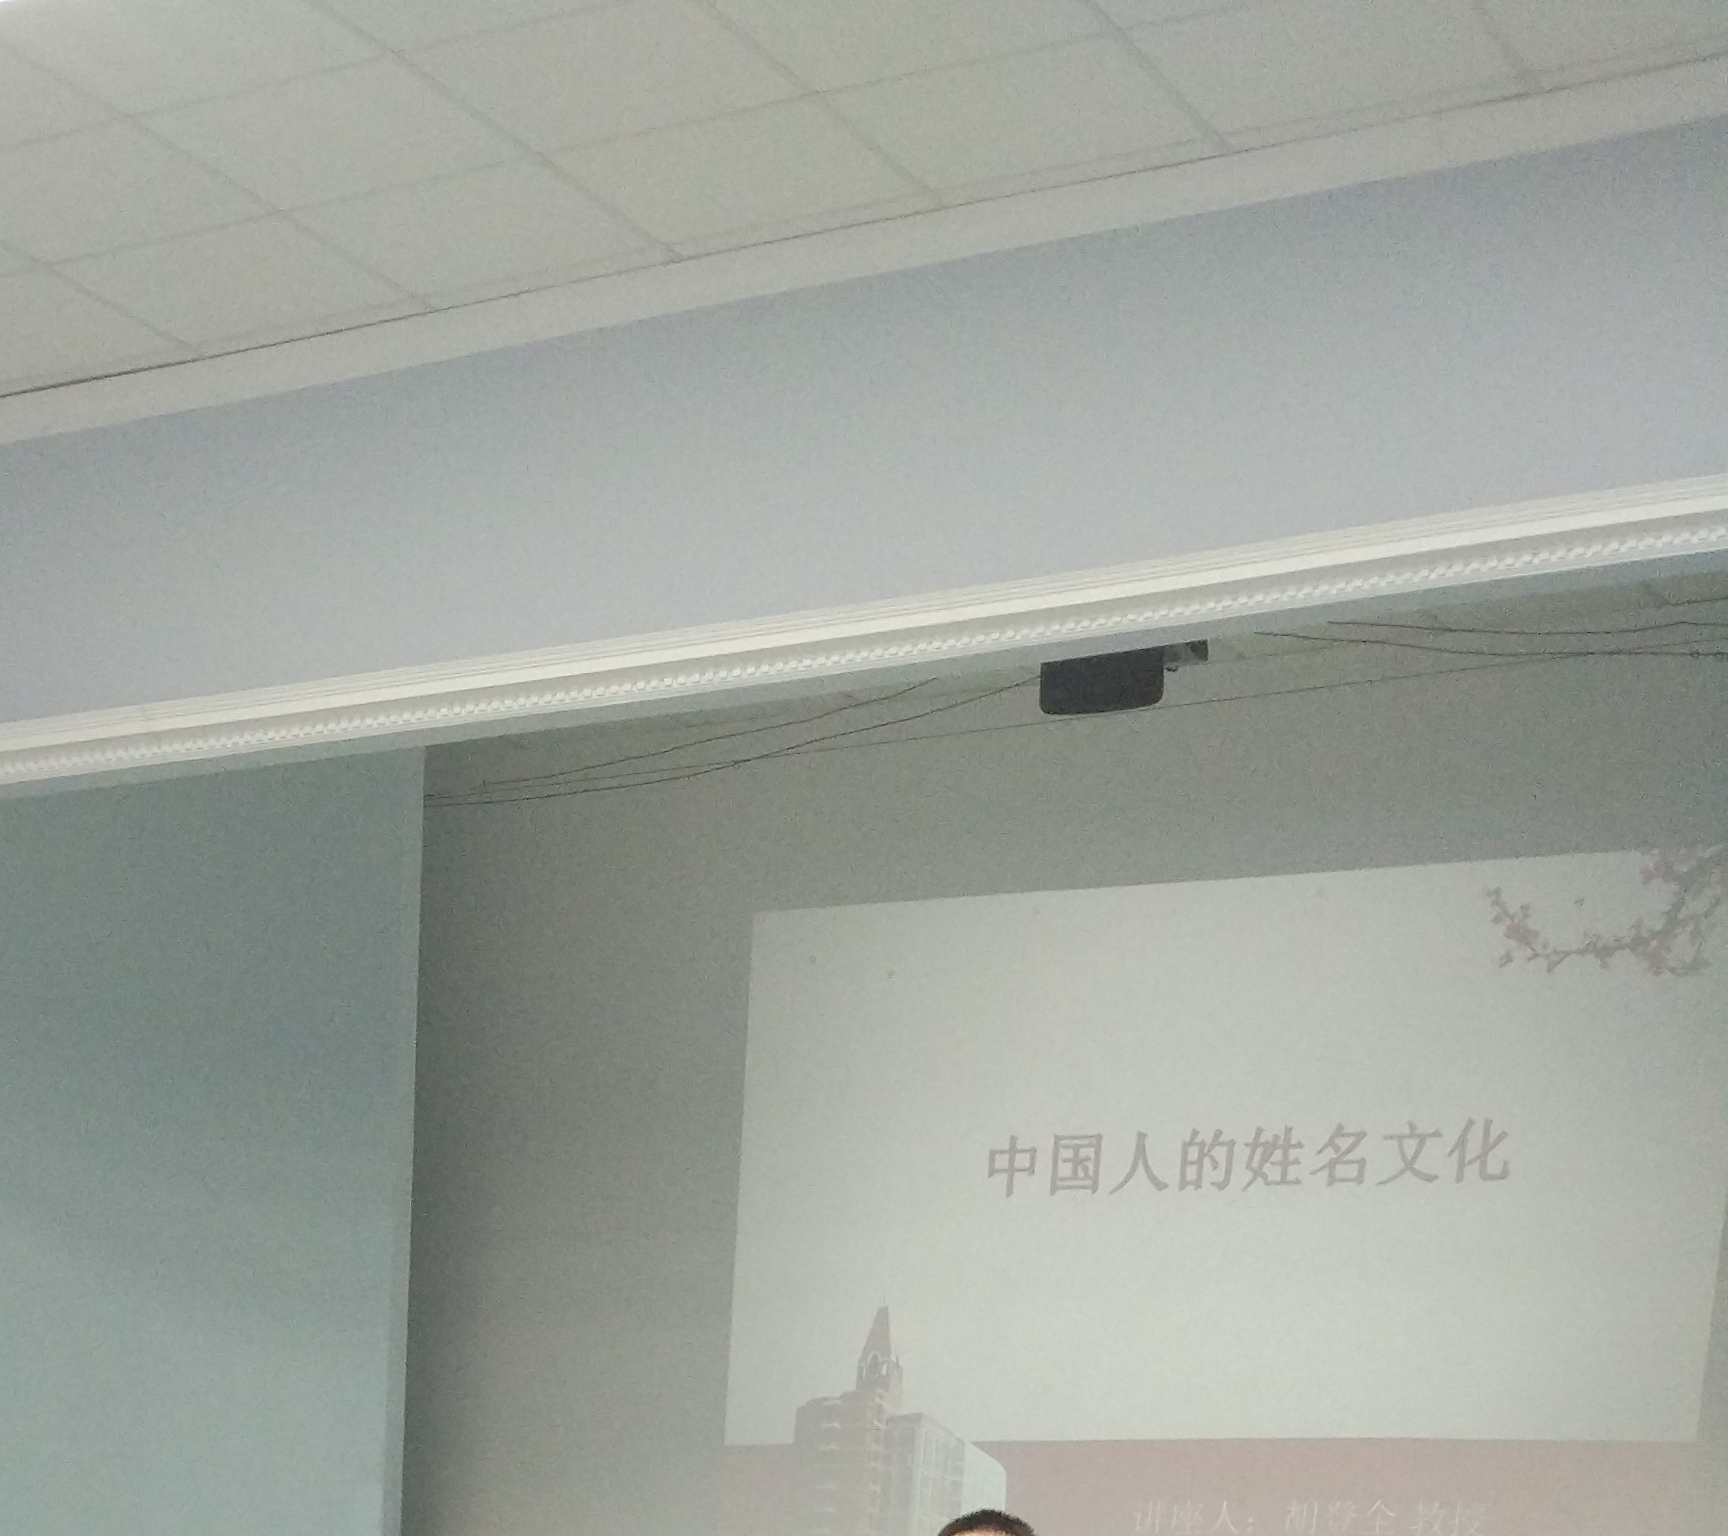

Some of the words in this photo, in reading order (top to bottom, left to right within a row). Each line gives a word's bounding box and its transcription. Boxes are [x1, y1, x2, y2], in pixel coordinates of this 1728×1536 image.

[986, 1117, 1511, 1199] 中国人的姓名文化
